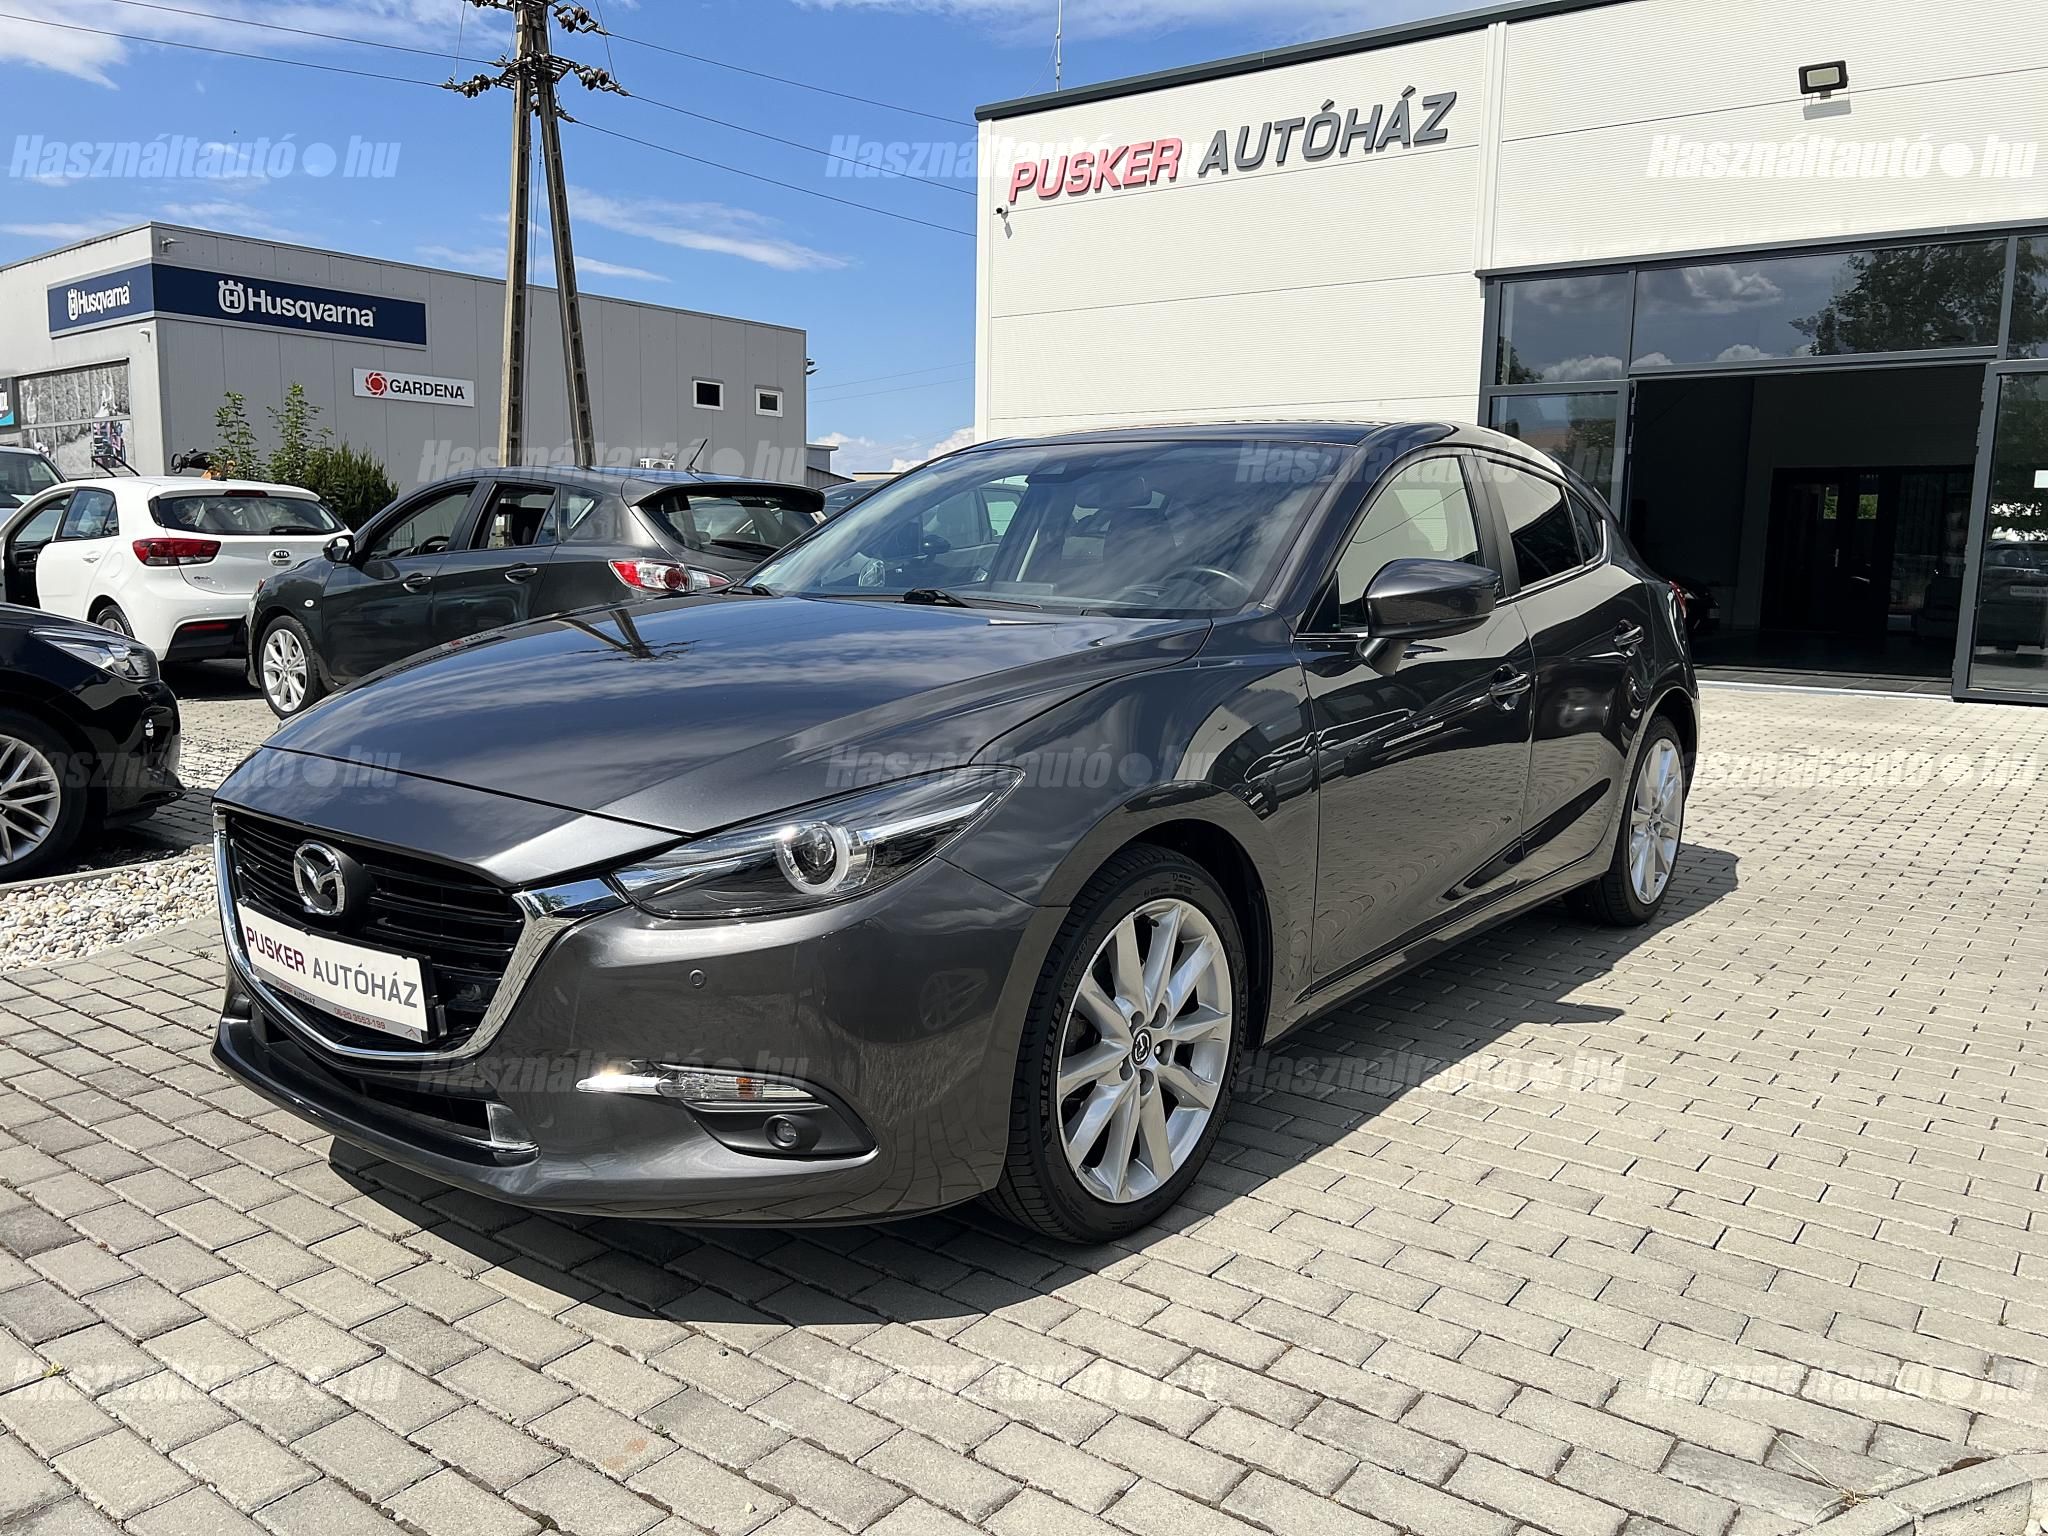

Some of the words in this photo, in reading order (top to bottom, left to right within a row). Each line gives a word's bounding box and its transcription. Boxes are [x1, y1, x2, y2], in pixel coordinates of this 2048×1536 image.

[1008, 137, 1183, 204] PUSKER
[1197, 85, 1457, 178] AUTÓHÁZ
[78, 285, 130, 314] Husqvarna
[248, 288, 374, 328] Husqvarna
[390, 379, 465, 399] GARDENA
[246, 926, 306, 974] PUSKER
[313, 957, 418, 1009] AUTÓHÁZ
[1040, 1001, 1063, 1116] MICHELIN
